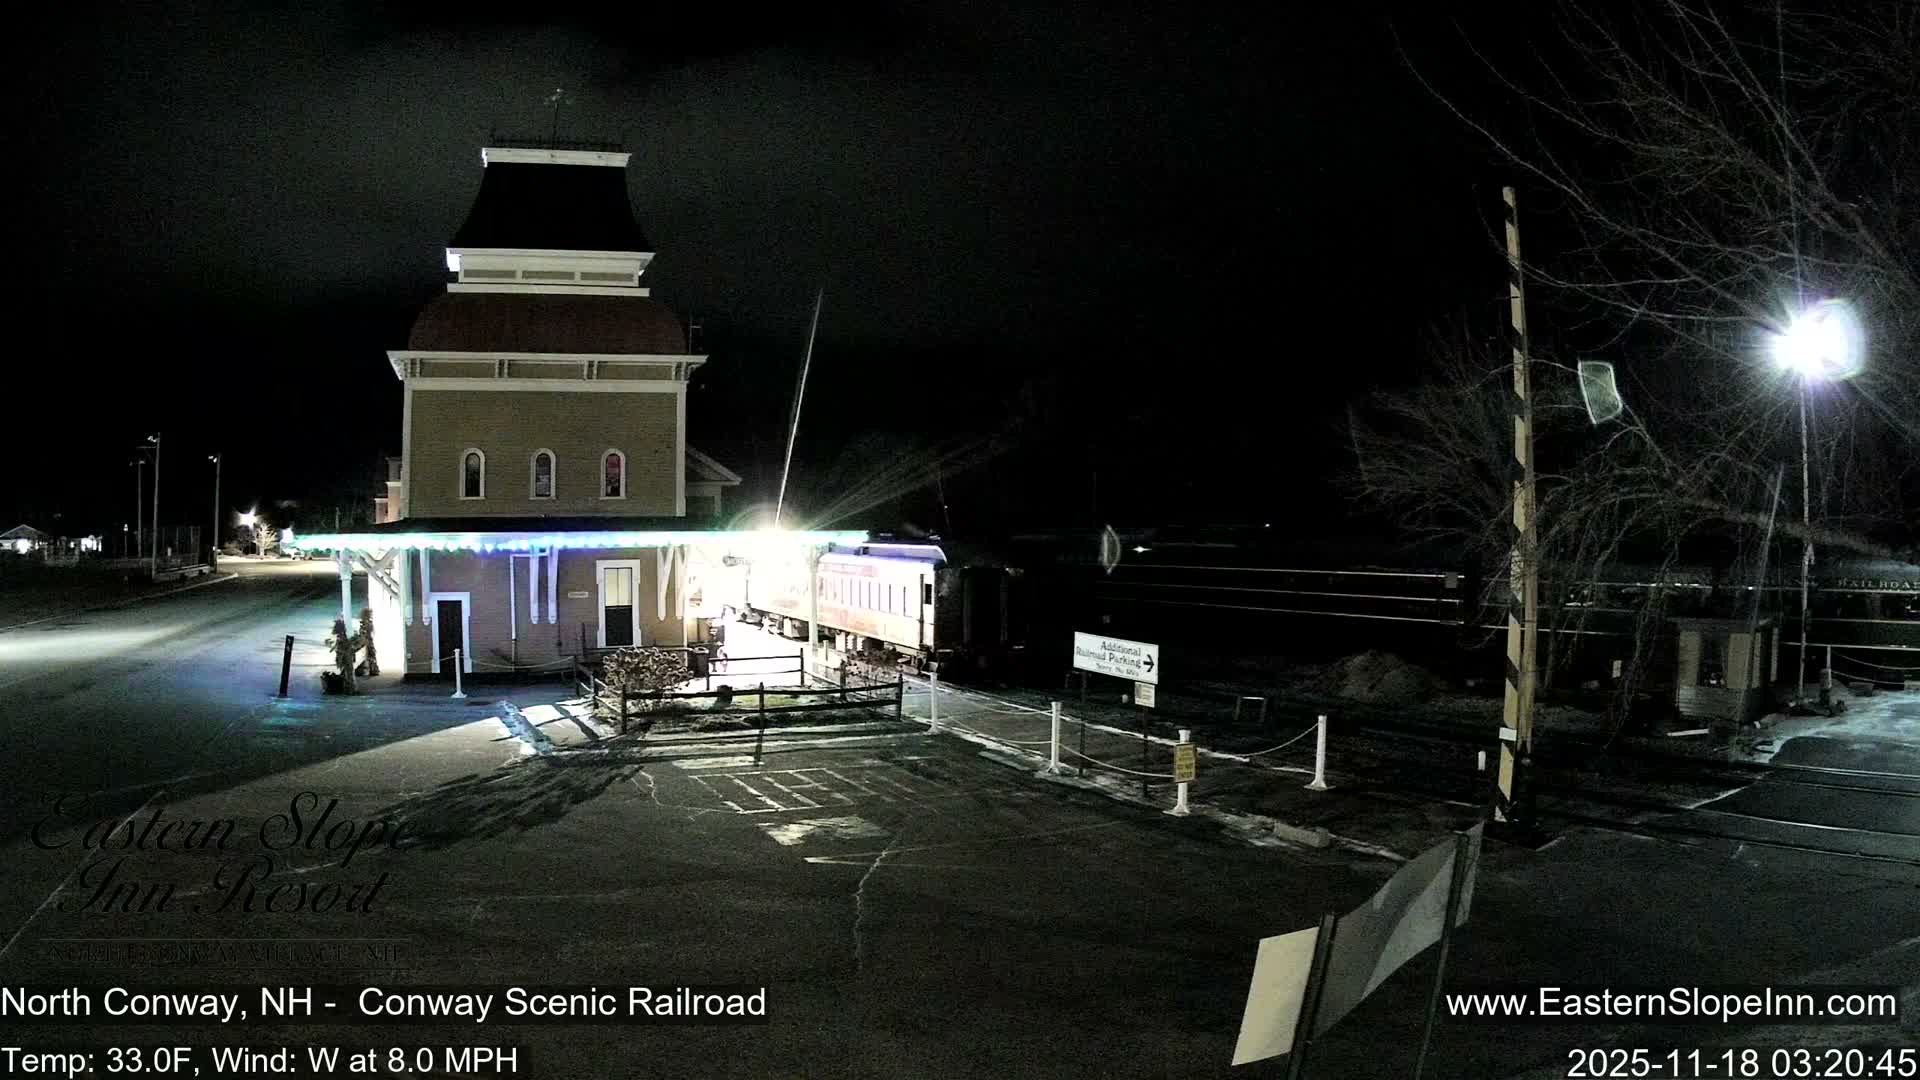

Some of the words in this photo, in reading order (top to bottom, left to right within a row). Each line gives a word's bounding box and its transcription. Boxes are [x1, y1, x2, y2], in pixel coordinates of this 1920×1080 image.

[1076, 646, 1105, 661] Railroad
[1108, 652, 1141, 669] Parking
[1100, 641, 1141, 656] Additional
